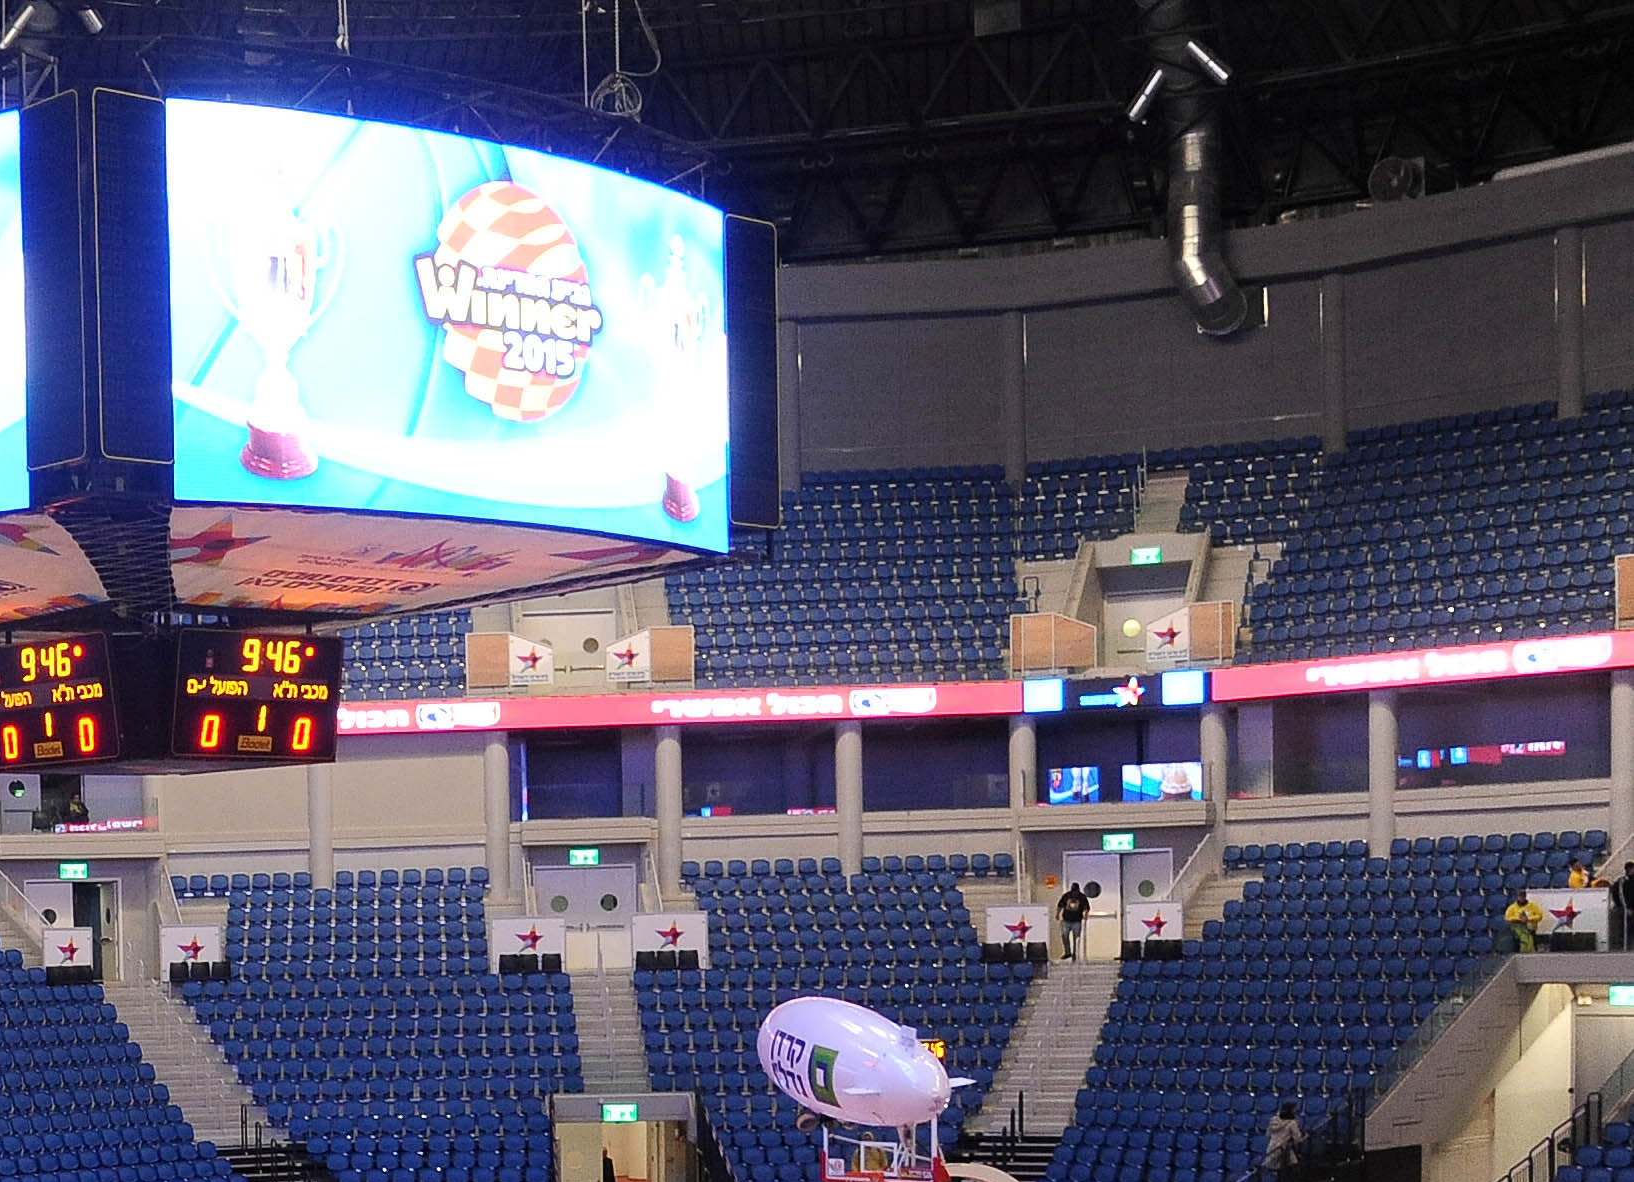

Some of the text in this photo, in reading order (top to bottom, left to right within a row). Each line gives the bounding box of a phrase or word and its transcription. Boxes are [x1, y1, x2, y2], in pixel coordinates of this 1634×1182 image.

[415, 254, 603, 344] Winner
[502, 333, 578, 378] 2015
[77, 682, 103, 699] מכבי
[210, 675, 249, 696] הפועל
[301, 685, 328, 700] מכבי
[45, 712, 53, 737] 1
[78, 717, 95, 752] 0
[200, 715, 220, 748] 0
[257, 705, 267, 732] 1
[292, 717, 311, 750] 0
[3, 726, 18, 759] 0
[771, 1029, 806, 1069] קרדן
